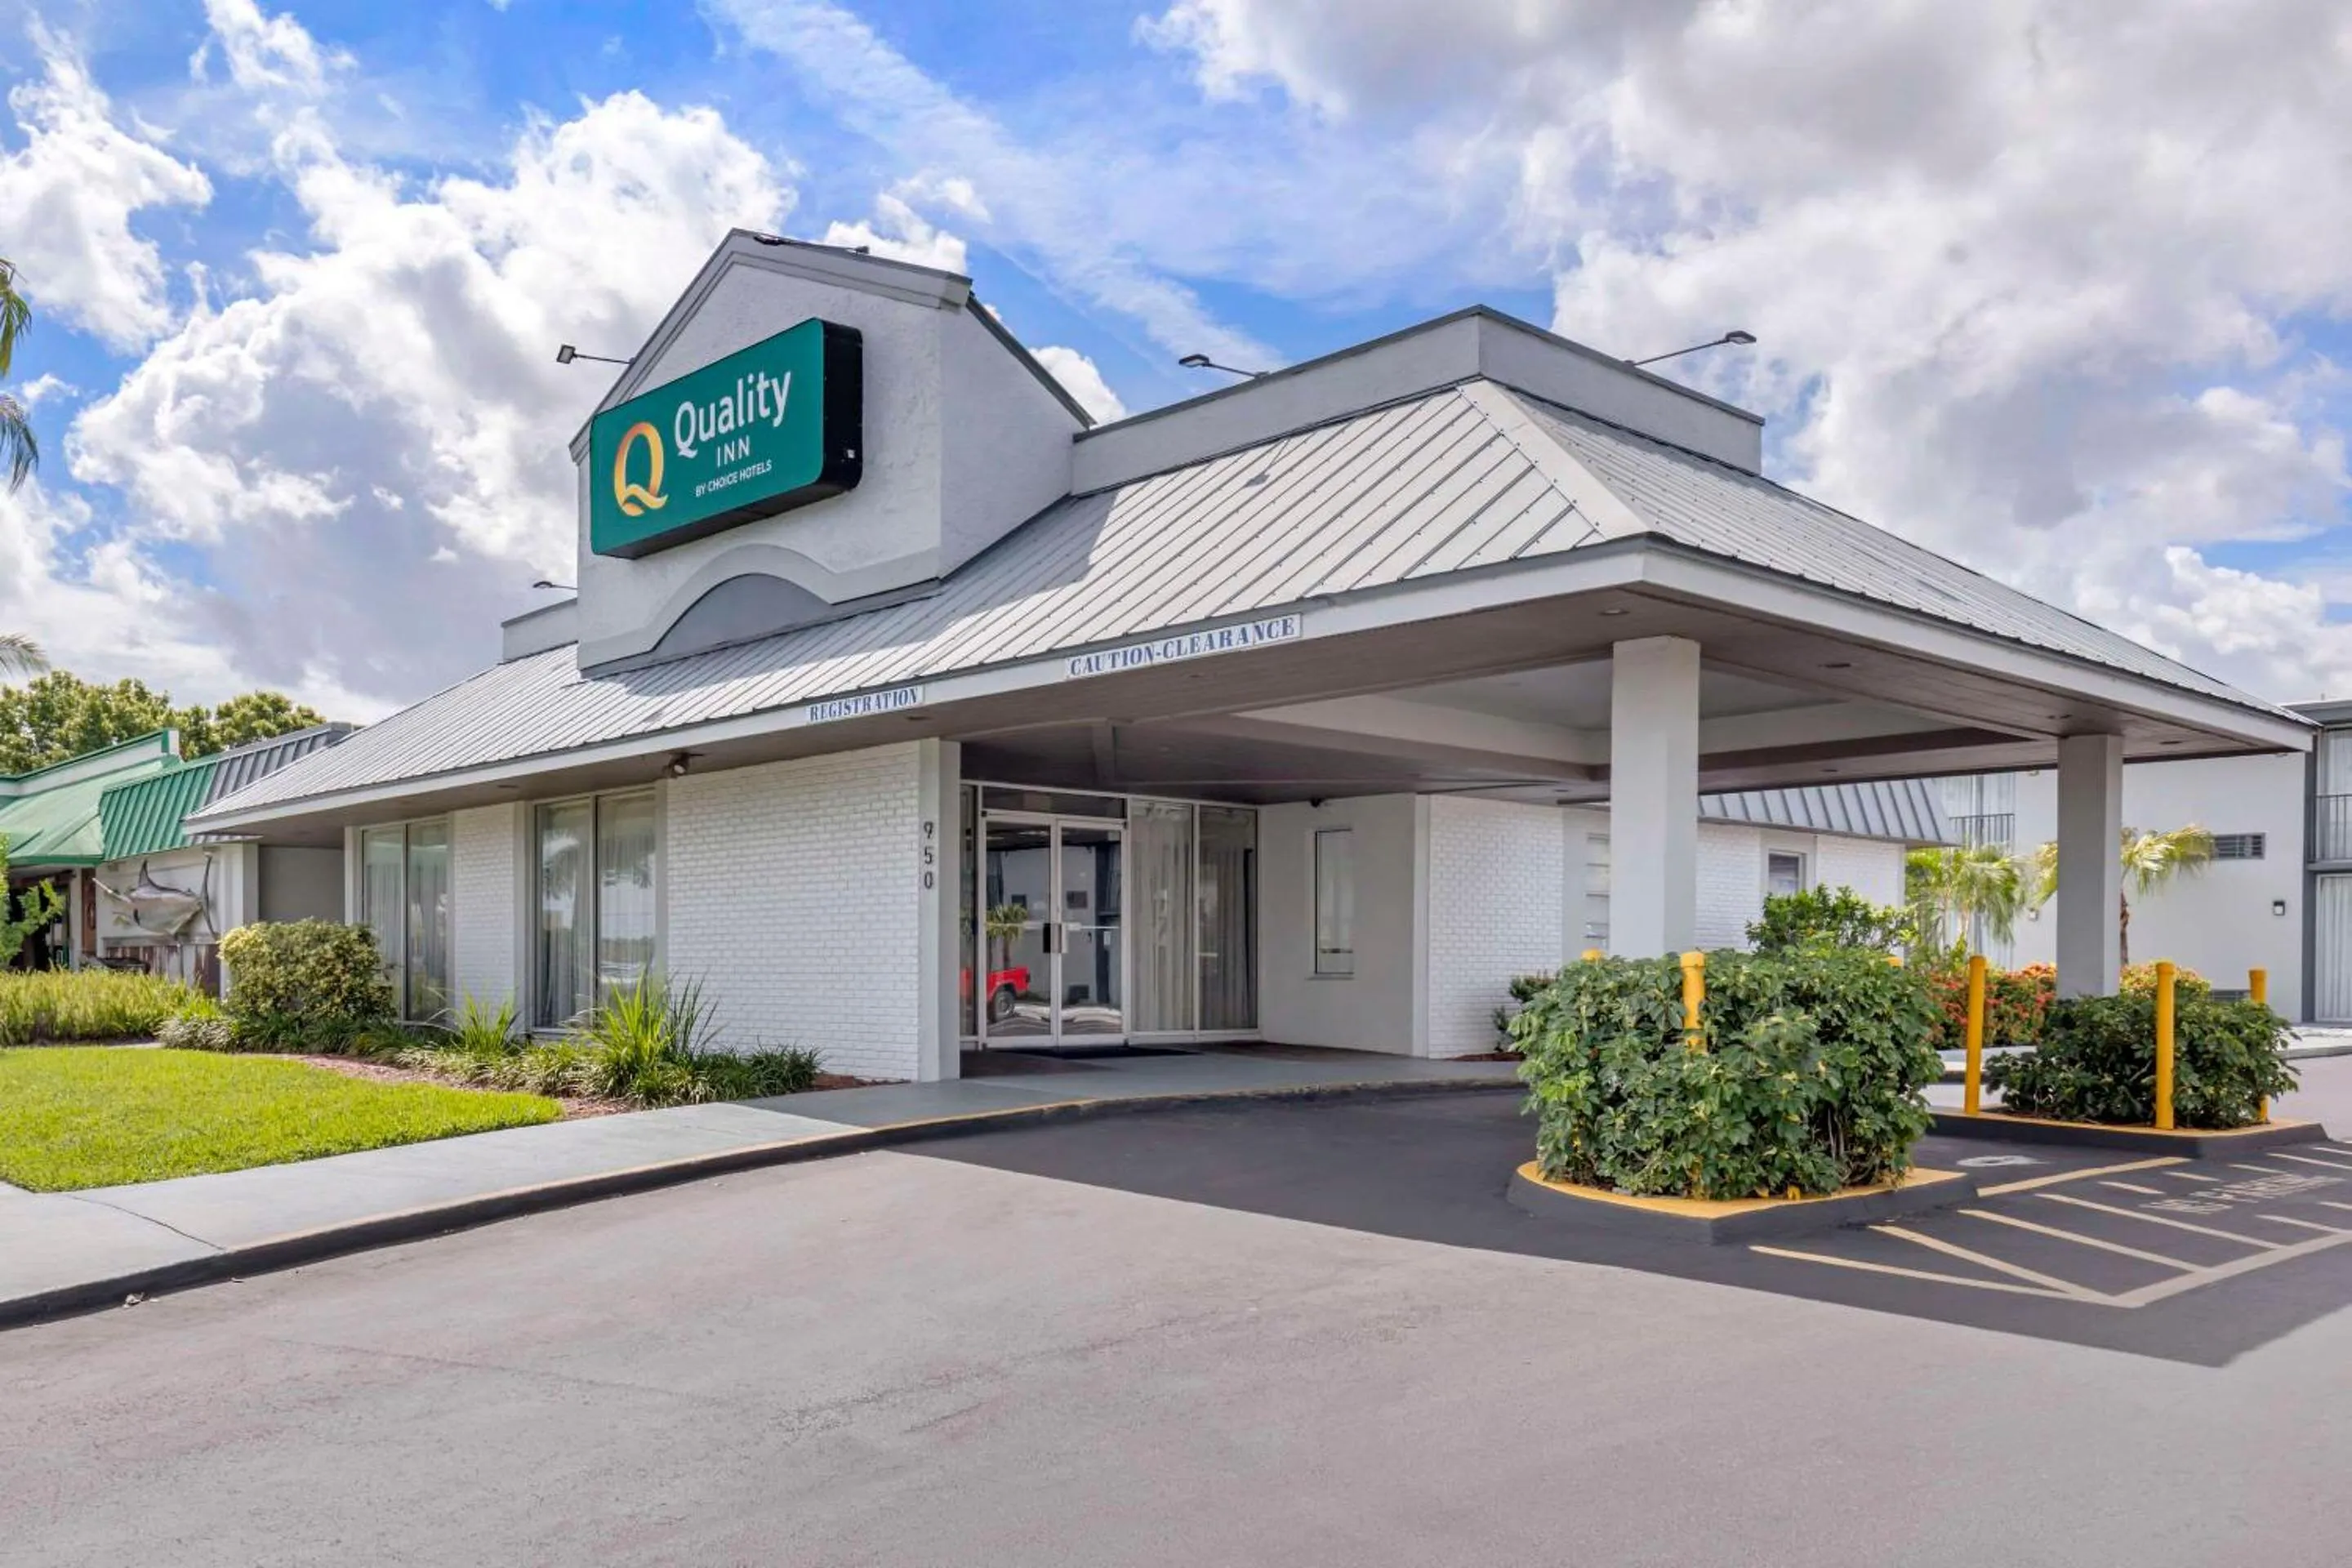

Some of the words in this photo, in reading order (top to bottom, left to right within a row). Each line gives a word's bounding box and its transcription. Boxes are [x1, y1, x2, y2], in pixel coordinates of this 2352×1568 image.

[675, 371, 791, 458] Quality
[614, 421, 669, 516] Q
[695, 483, 706, 497] BY
[708, 471, 738, 492] CHOICE
[739, 458, 772, 482] HOTELS
[717, 434, 750, 468] INN
[809, 688, 918, 721] REGISTRATION
[924, 821, 933, 889] 950
